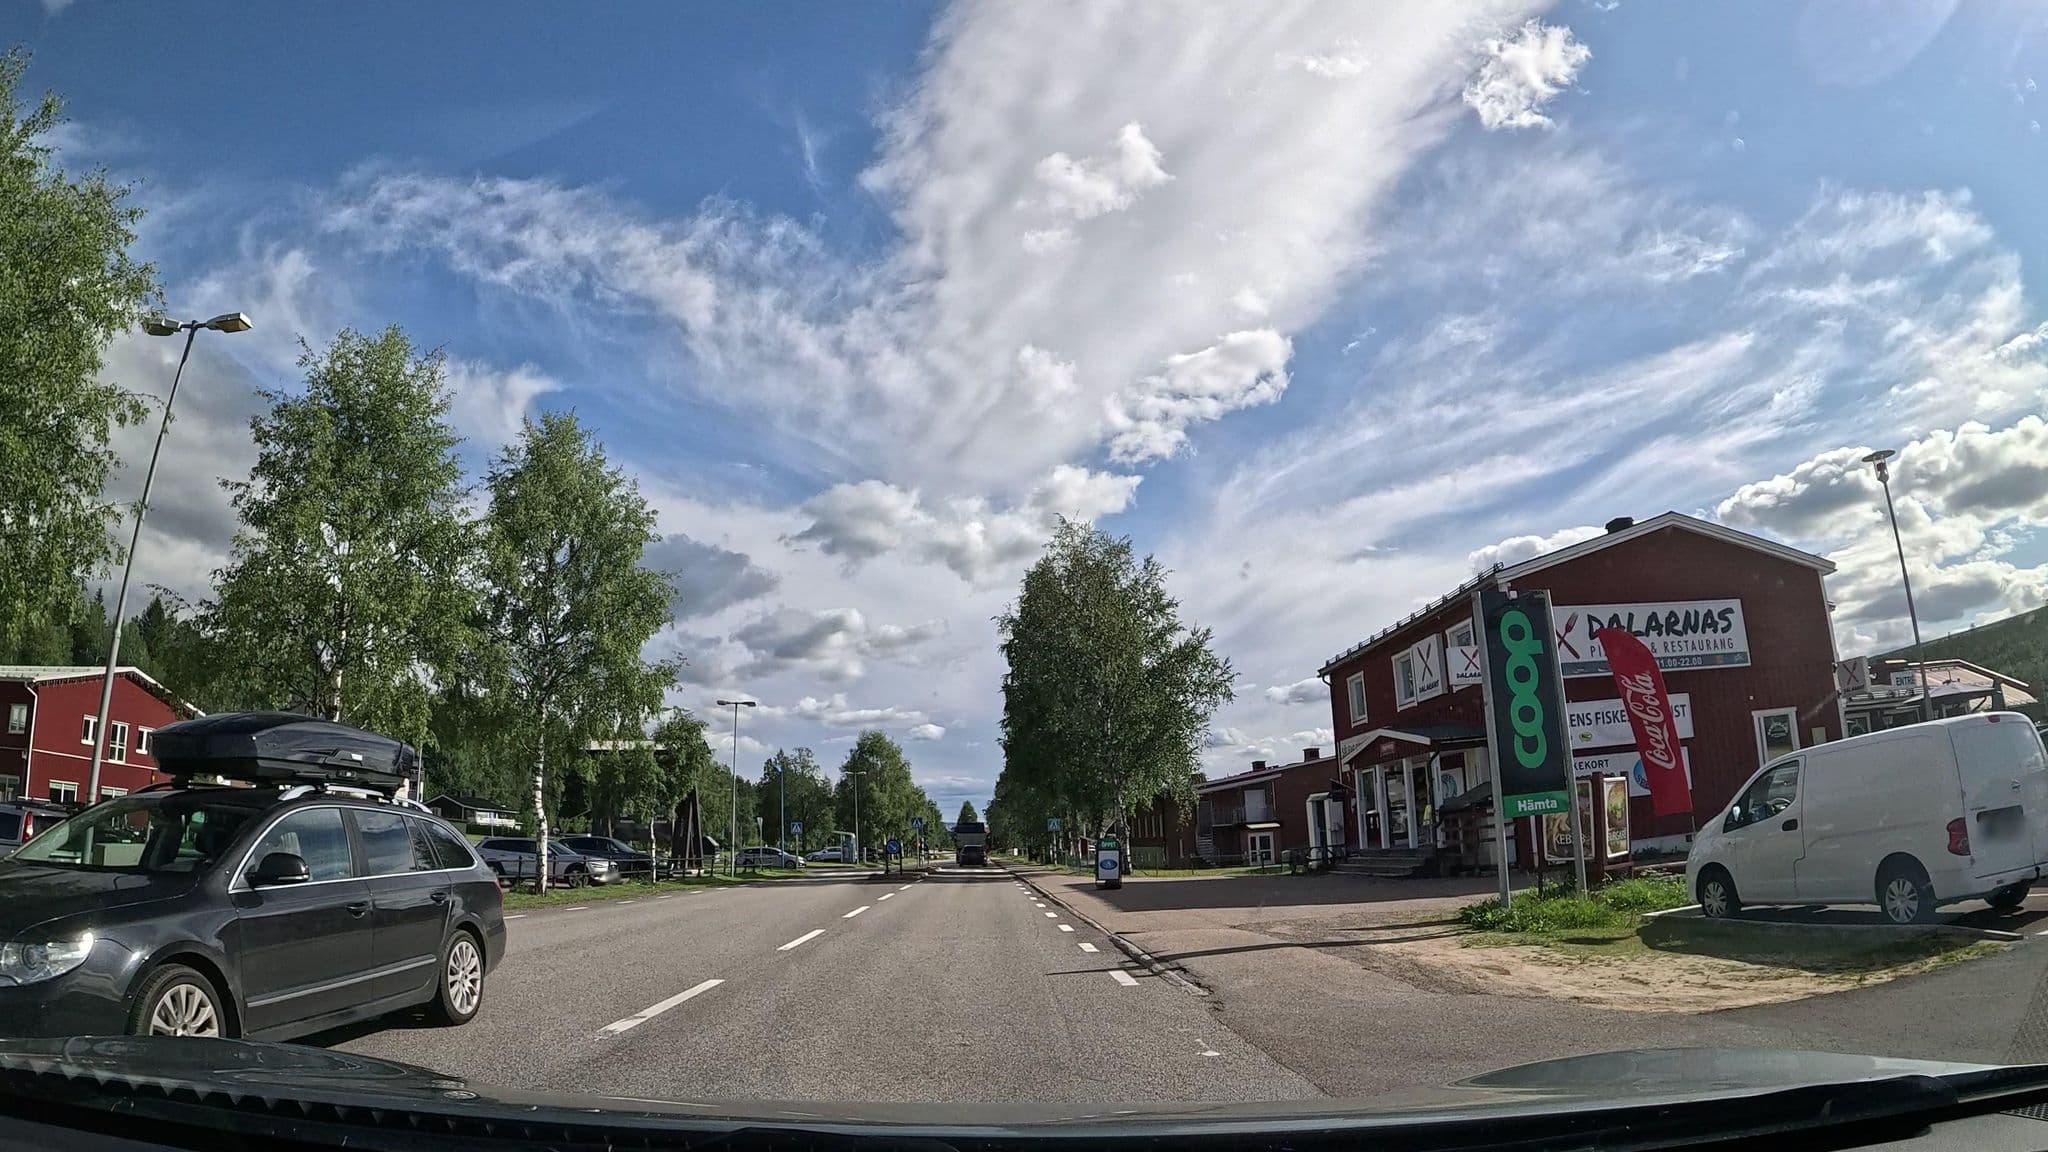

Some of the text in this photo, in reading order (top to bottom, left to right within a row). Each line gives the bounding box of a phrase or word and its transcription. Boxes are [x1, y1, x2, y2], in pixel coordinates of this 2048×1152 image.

[1587, 607, 1735, 640] DALARNAS
[1663, 637, 1734, 654] RESTAURANG
[1500, 610, 1548, 769] coop
[1570, 712, 1592, 727] ENS
[1595, 709, 1630, 725] FISKE
[1517, 799, 1558, 812] Hämta
[1553, 833, 1586, 845] KEBB
